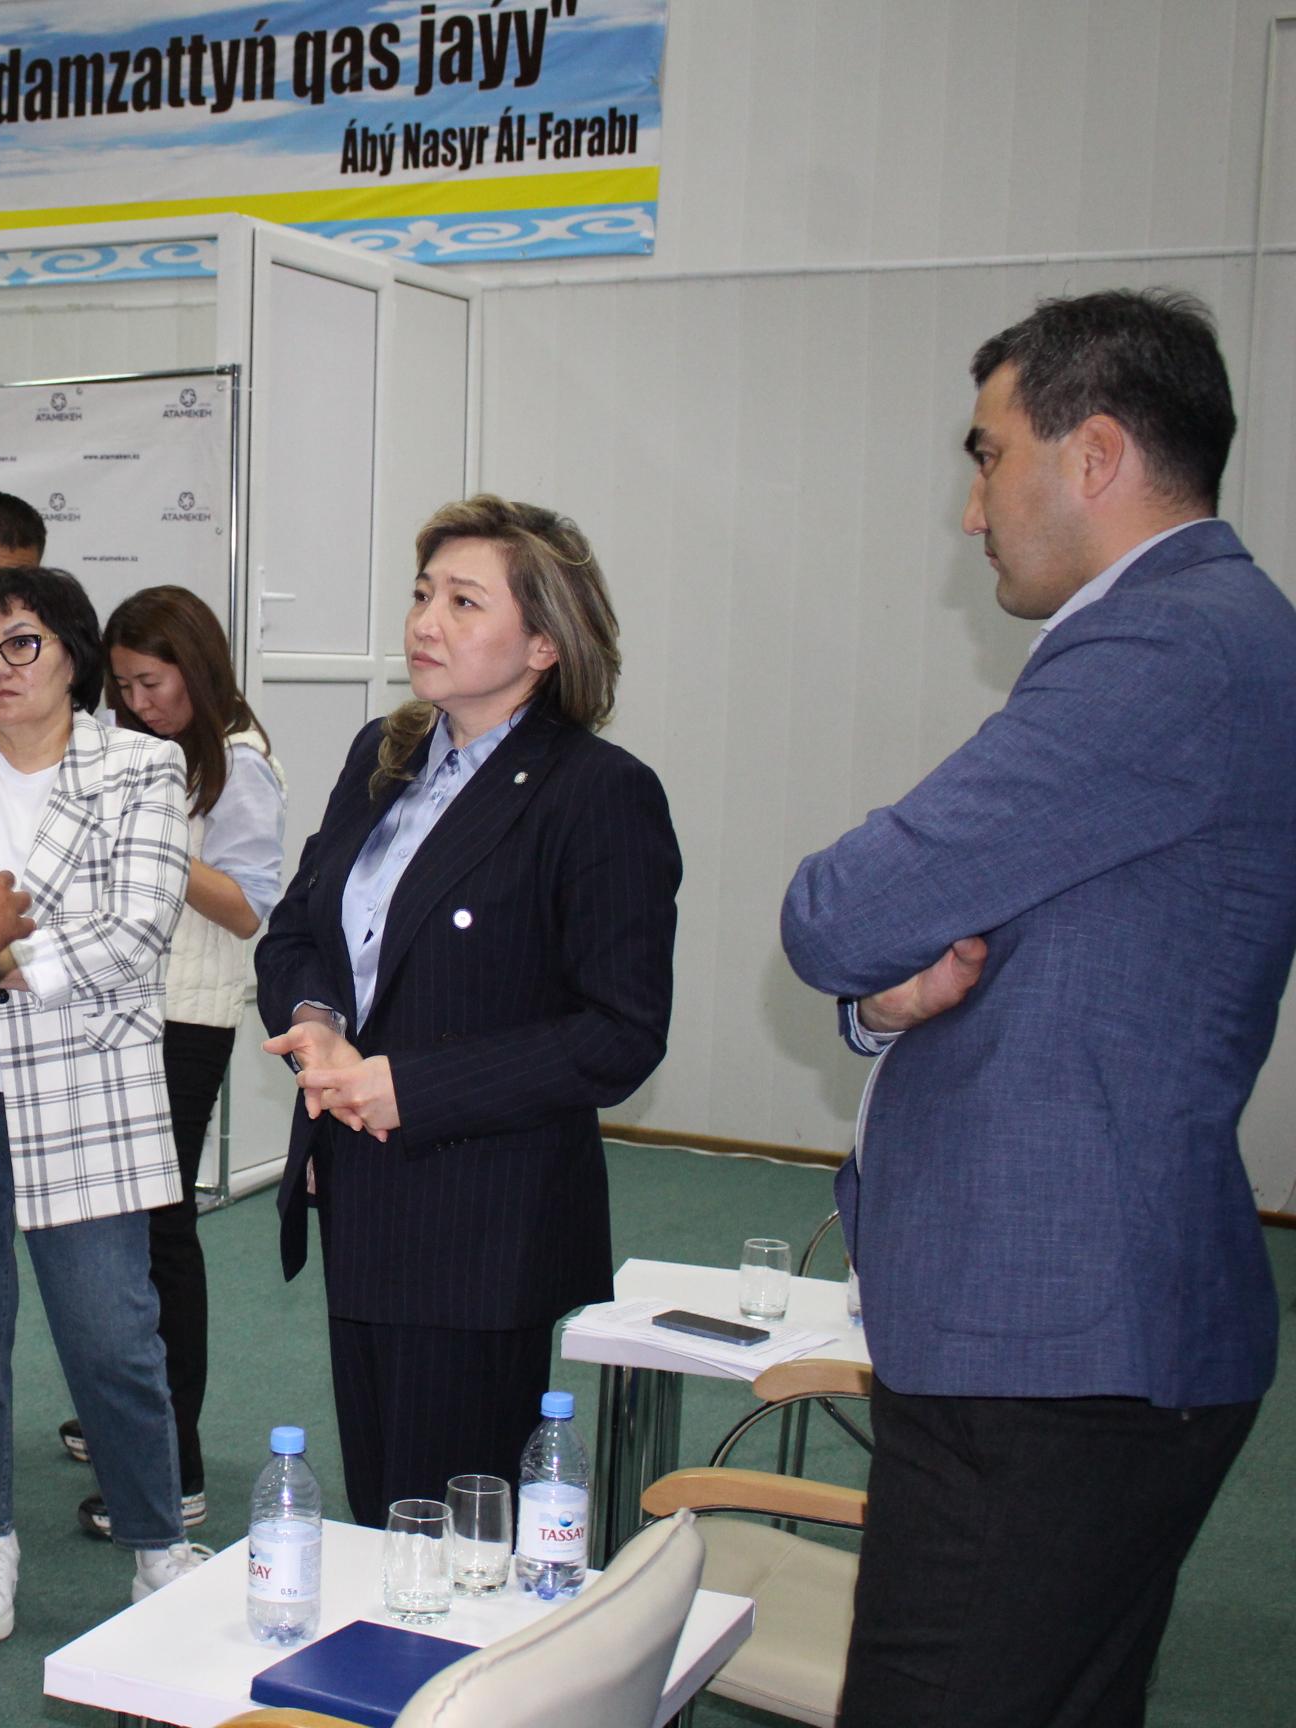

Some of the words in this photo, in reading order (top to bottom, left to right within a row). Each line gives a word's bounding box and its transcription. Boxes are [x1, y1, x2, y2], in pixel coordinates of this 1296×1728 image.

[292, 21, 401, 105] qas
[401, 121, 490, 172] Nasyr
[538, 1527, 585, 1542] TASSAY
